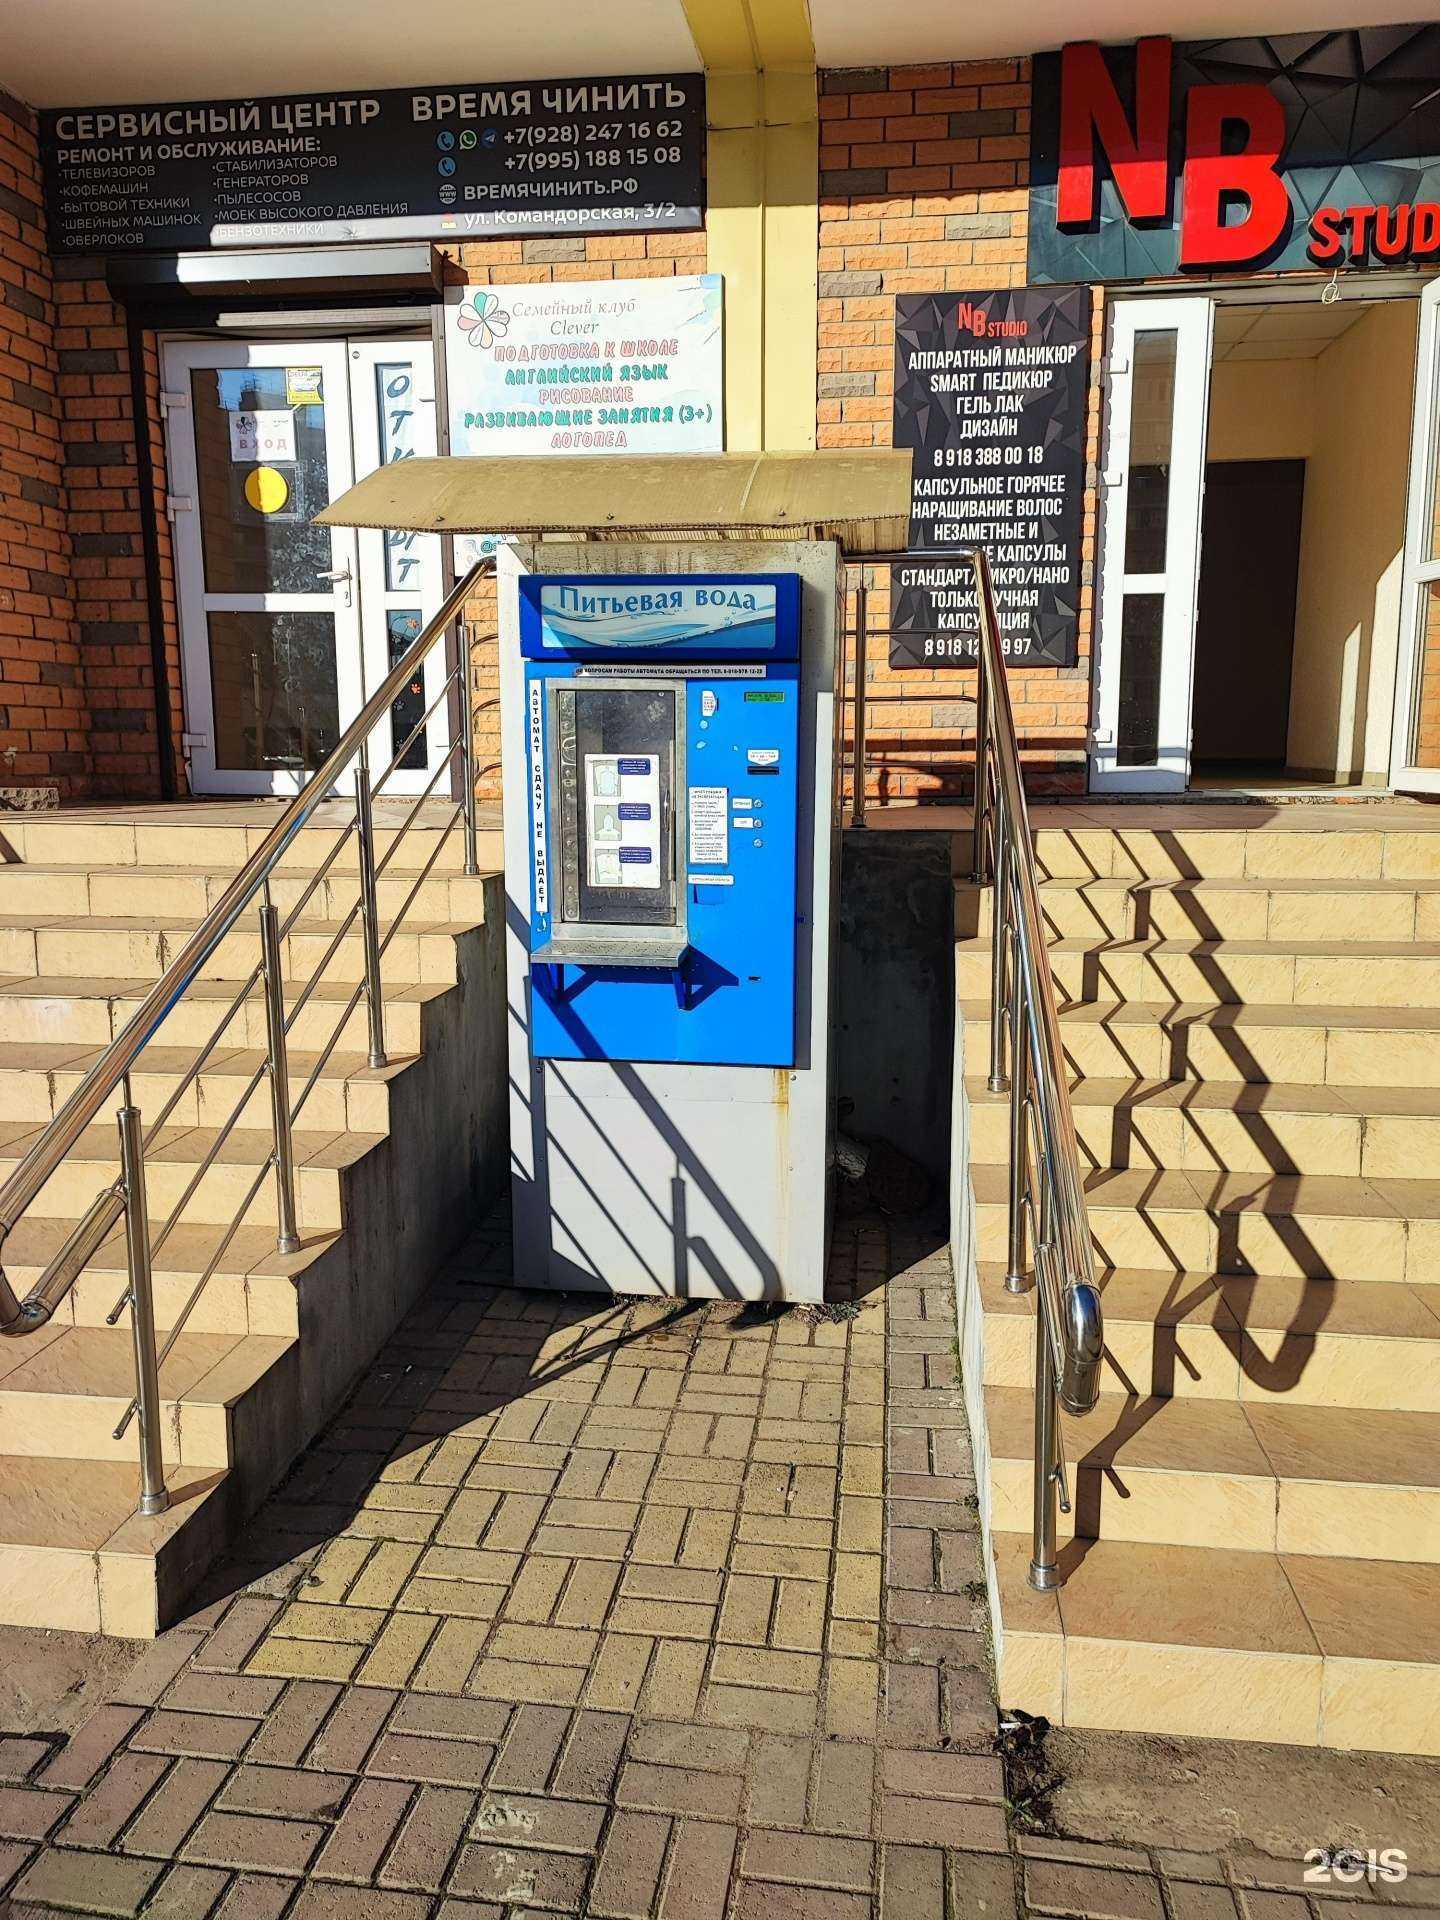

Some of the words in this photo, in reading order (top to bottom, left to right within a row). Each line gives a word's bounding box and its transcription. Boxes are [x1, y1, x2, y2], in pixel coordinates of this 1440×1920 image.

[412, 90, 531, 121] ВРЕМЯ
[542, 83, 686, 114] ЧИНИТЬ
[56, 101, 260, 140] СЕРВИСНЫЙ
[271, 99, 380, 134] ЦЕНТР
[504, 124, 580, 147] +7(928)
[585, 123, 622, 142] 247
[628, 121, 650, 140] 16
[657, 120, 682, 138] 62
[57, 146, 135, 164] РЕМОНТ
[140, 146, 152, 161] И
[157, 136, 321, 159] ОБСЛУЖИВАНИЕ:
[504, 150, 580, 173] +7(995)
[587, 149, 620, 167] 188
[629, 148, 648, 165] 15
[654, 146, 680, 164] 08
[1056, 36, 1291, 268] NB
[62, 165, 156, 180] ТЕЛЕВИЗОРОВ
[215, 156, 338, 173] СТАБИЛИЗАТОРОВ
[63, 183, 149, 197] КОФЕМАШИН
[217, 174, 309, 189] ГЕНЕРАТОРОВ
[464, 178, 638, 200] ВРЕМЯЧИНИТЬ.РФ
[64, 199, 127, 213] БЫТОВОЙ
[131, 197, 190, 211] ТЕХНИКИ
[218, 190, 301, 205] ПЫЛЕСОСОВ
[65, 216, 130, 230] ШВЕЙНЫХ
[133, 214, 202, 227] МАШИНОК
[218, 209, 256, 222] МОЕК
[260, 205, 334, 221] ВЫСОКОГО
[337, 202, 408, 219] ДАВЛЕНИЯ
[464, 213, 490, 229] ул.
[494, 207, 640, 226] Командорская,
[644, 202, 676, 219] 3/2
[66, 232, 144, 246] ОВЕРЛОКОВ
[219, 223, 324, 238] БЕНЗОТЕХНИКИ
[512, 298, 592, 317] Семейный
[598, 298, 637, 315] клуб
[550, 320, 600, 336] Clever
[958, 302, 987, 337] NB
[988, 320, 1028, 338] STUDIO
[494, 342, 600, 362] ПОДГОТОВКА
[604, 341, 616, 359] К
[620, 338, 679, 357] ШКОЛЕ
[908, 345, 1001, 370] АППАРАТНЫЙ
[1004, 345, 1077, 366] МАНИКЮР
[505, 362, 613, 385] АНГЛИЙСКИЙ
[619, 363, 669, 381] ЯЗЫК
[930, 373, 976, 392] SMART
[983, 370, 1053, 392] ПЕДИКЮР
[538, 386, 634, 405] РИСОВАНИЕ
[956, 396, 992, 415] ГЕЛЬ
[993, 395, 1024, 414] ЛАК
[464, 409, 593, 429] РАЗВИВАЮЩИЕ
[597, 406, 674, 425] ЗАНЯТИЯ
[678, 403, 713, 424] (3+)
[960, 416, 1018, 439] ДИЗАЙН
[239, 438, 288, 451] ВХОД
[551, 430, 628, 449] ЛОГОПЕД
[933, 449, 943, 467] 8
[946, 447, 972, 466] 918
[975, 447, 1001, 466] 388
[1004, 446, 1022, 465] 00
[1027, 445, 1043, 464] 18
[914, 476, 1004, 496] КАПСУЛЬНОЕ
[1007, 474, 1066, 494] ГОРЯЧЕЕ
[912, 499, 1013, 519] НАРАЩИВАНИЕ
[1016, 498, 1062, 517] ВОЛОС
[934, 522, 1025, 541] НЕЗАМЕТНЫЕ
[1028, 521, 1038, 540] И
[997, 544, 1067, 562] КАПСУЛЫ
[901, 566, 1070, 587] СТАНДАРТ/ИКРО/НАНО
[559, 586, 683, 614] Питьевая
[695, 588, 757, 611] вода
[994, 589, 1039, 608] УЧНАЯ
[924, 639, 933, 656] 8
[936, 638, 962, 656] 918
[1014, 638, 1031, 655] 97
[532, 689, 541, 753] АВТОМАТ
[534, 765, 542, 809] СДАЧУ
[536, 821, 543, 838] НЕ
